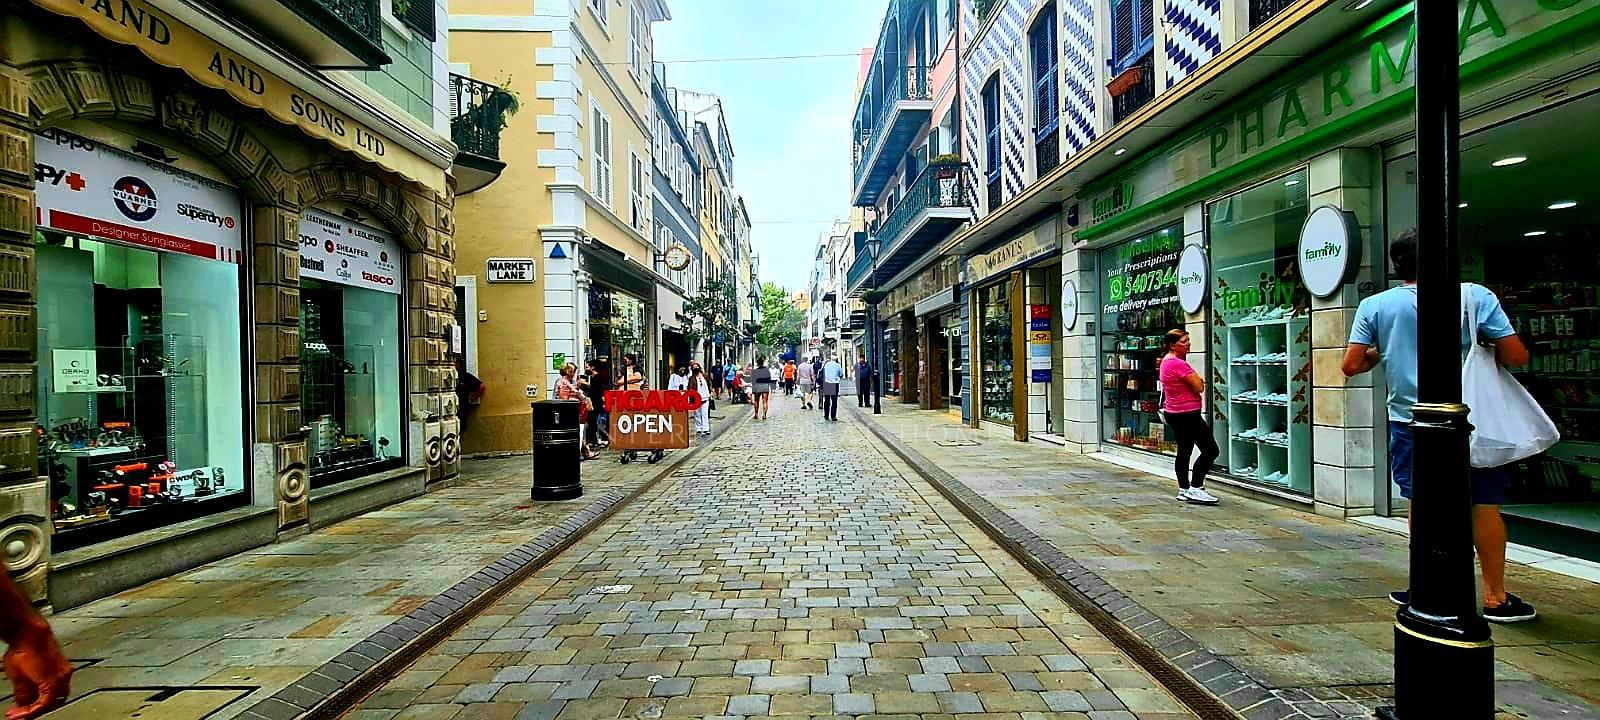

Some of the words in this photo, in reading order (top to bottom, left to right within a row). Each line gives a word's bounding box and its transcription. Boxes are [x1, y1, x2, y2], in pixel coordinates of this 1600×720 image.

[1209, 0, 1574, 168] PHARMA
[208, 52, 265, 96] AND
[290, 94, 345, 137] SONS
[355, 127, 386, 157] LTD
[113, 188, 158, 209] VUARNET
[92, 222, 140, 241] Designer
[141, 232, 192, 251] Sunglasses
[336, 243, 369, 257] SHEAFFER
[490, 262, 533, 271] MARKET
[1124, 251, 1178, 273] Prescriptions
[362, 270, 394, 286] tasco
[496, 271, 526, 280] LANE
[1104, 303, 1118, 314] Free
[1119, 299, 1148, 312] delivery
[603, 390, 702, 413] FIGARO
[618, 414, 672, 434] OPEN
